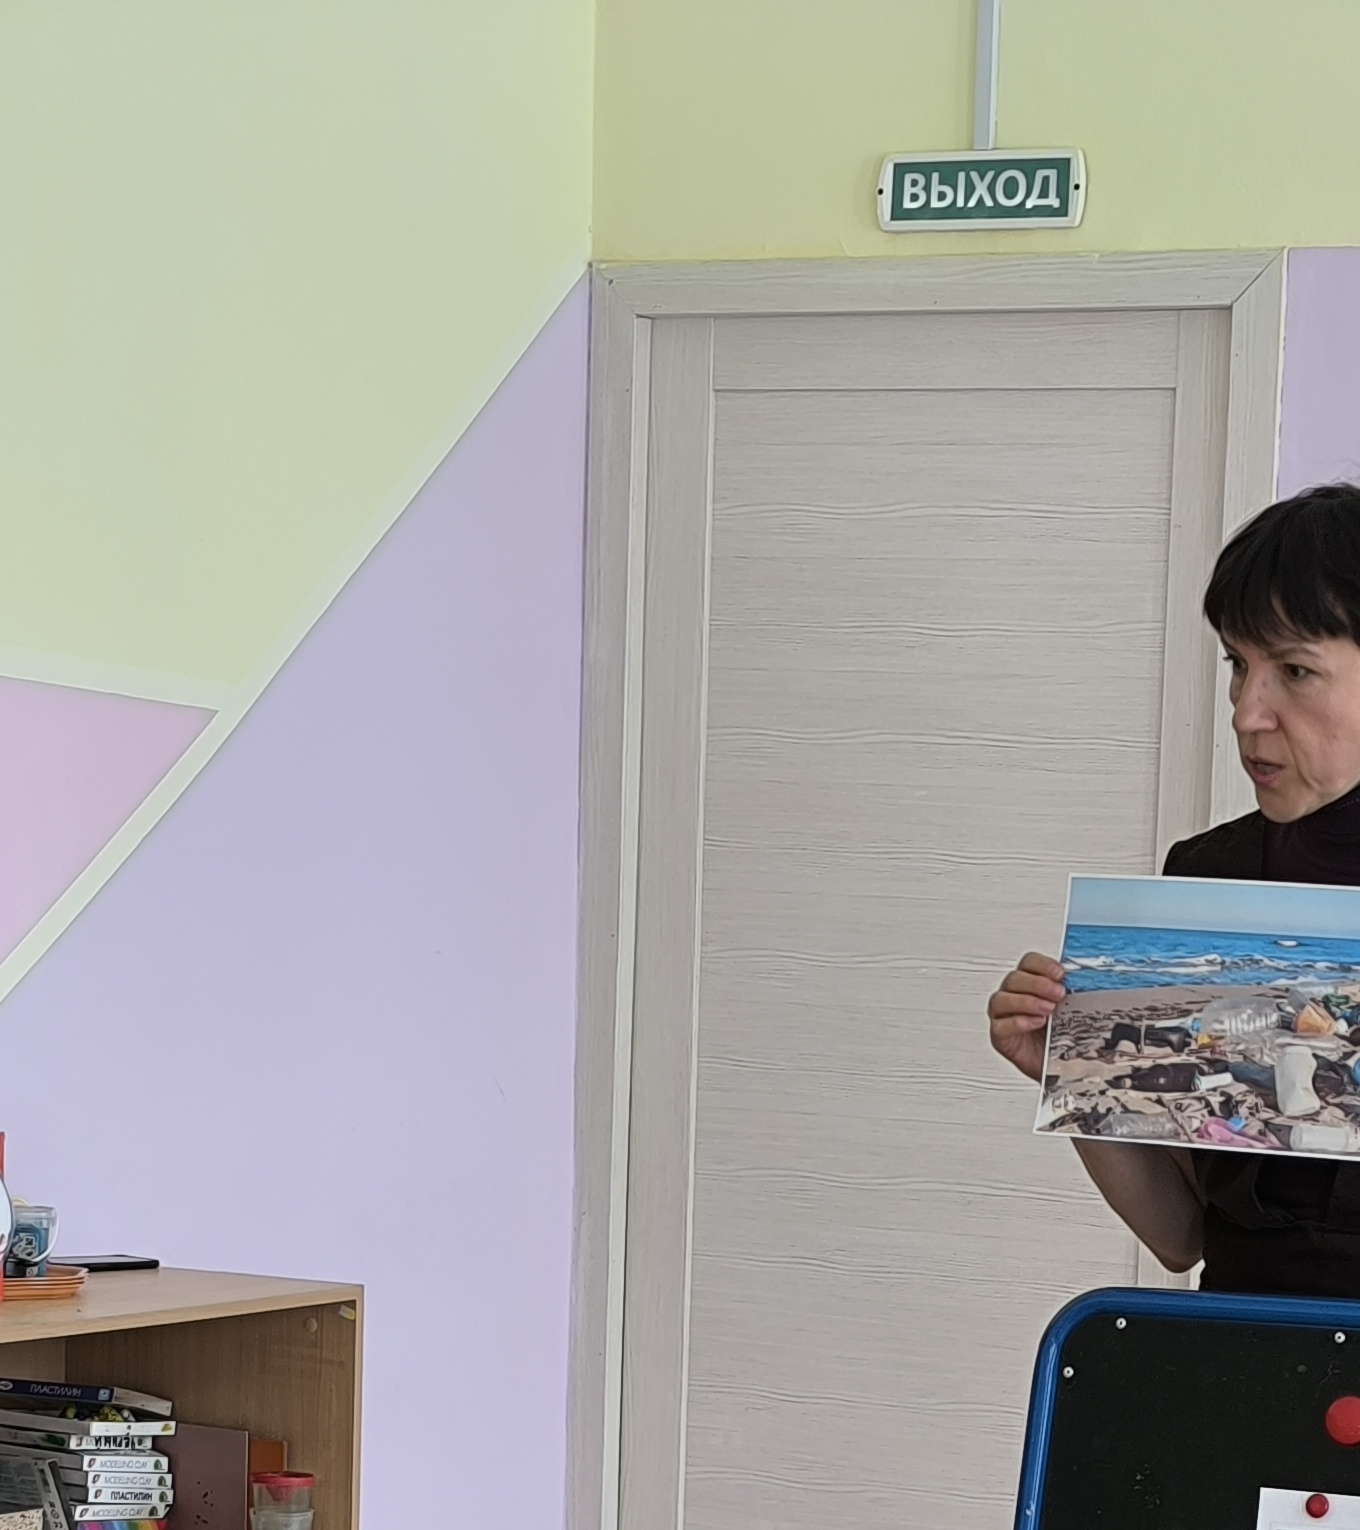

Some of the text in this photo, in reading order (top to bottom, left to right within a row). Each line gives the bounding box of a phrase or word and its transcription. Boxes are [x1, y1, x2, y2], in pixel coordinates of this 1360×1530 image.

[902, 168, 1061, 209] ВЫХОД
[29, 1383, 82, 1397] ПЛАСТИЛИН
[110, 1491, 153, 1501] ПЛАСТИЛИН
